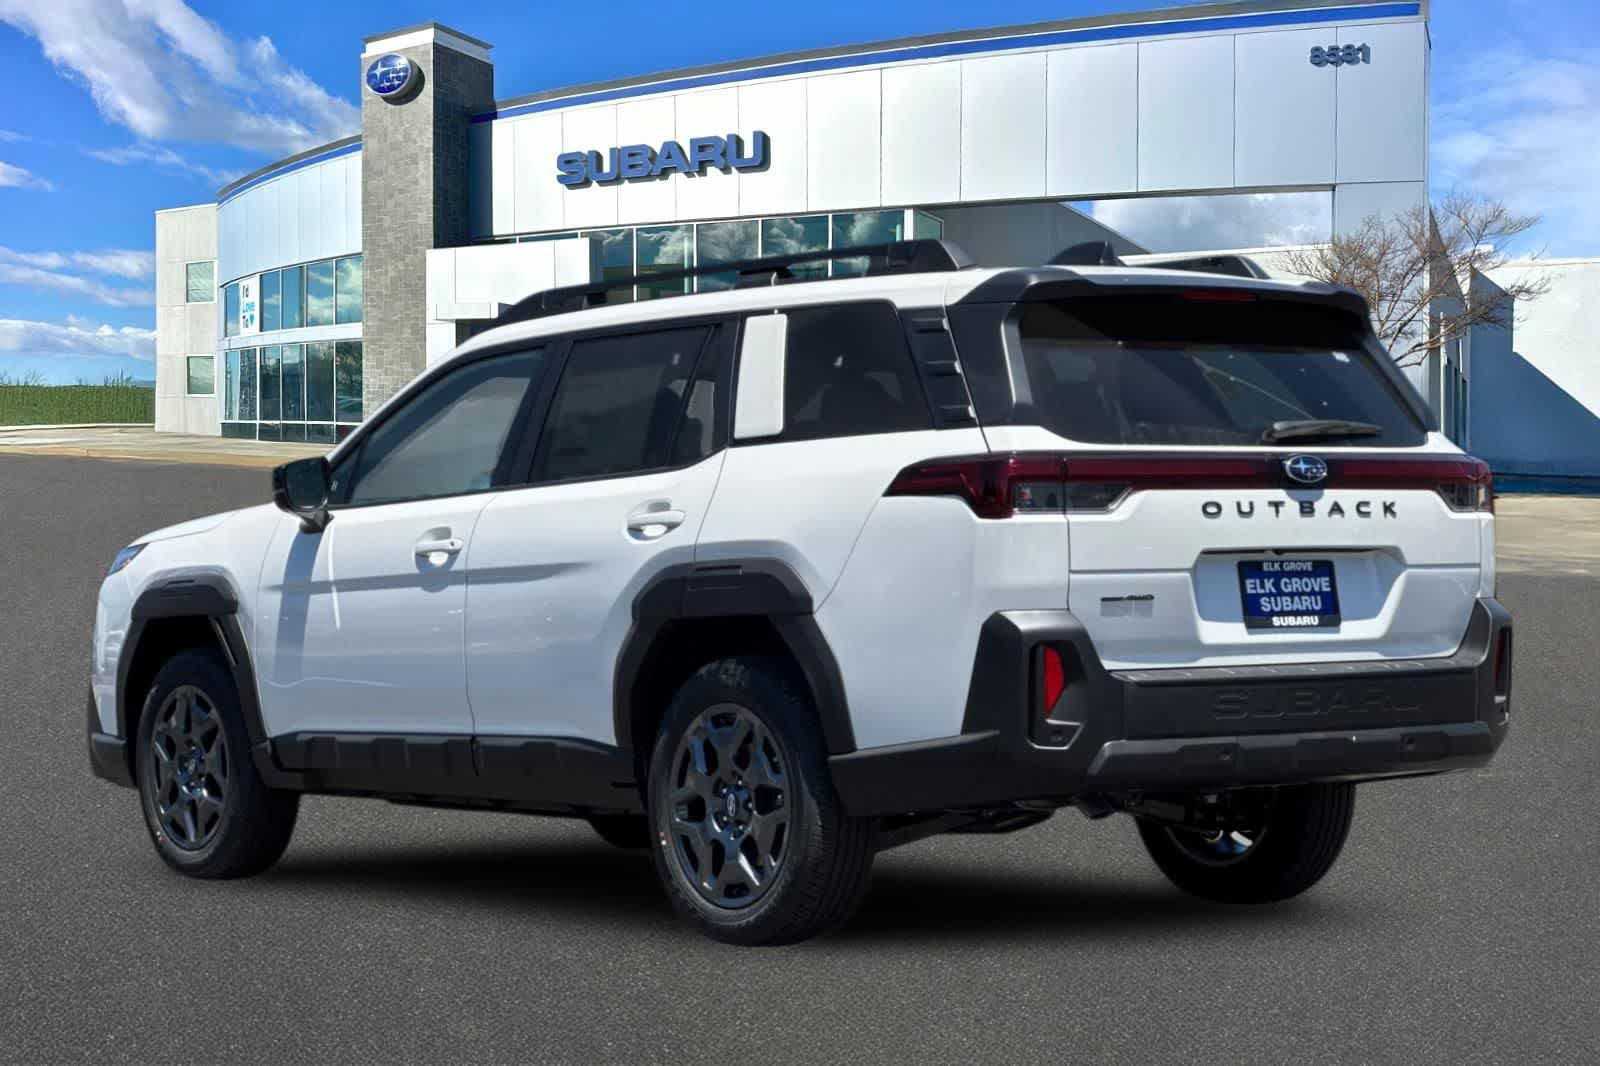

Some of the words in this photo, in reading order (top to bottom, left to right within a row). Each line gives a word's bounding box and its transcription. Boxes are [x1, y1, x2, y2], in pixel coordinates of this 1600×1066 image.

[557, 130, 771, 190] SUBARU
[1201, 500, 1398, 519] OUTBACK
[1263, 561, 1280, 572] ELK
[1283, 561, 1313, 571] GROVE
[1246, 578, 1276, 594] ELK
[1280, 576, 1331, 592] GROVE
[1260, 596, 1322, 613] SUBARU
[1272, 616, 1319, 626] SUBARU
